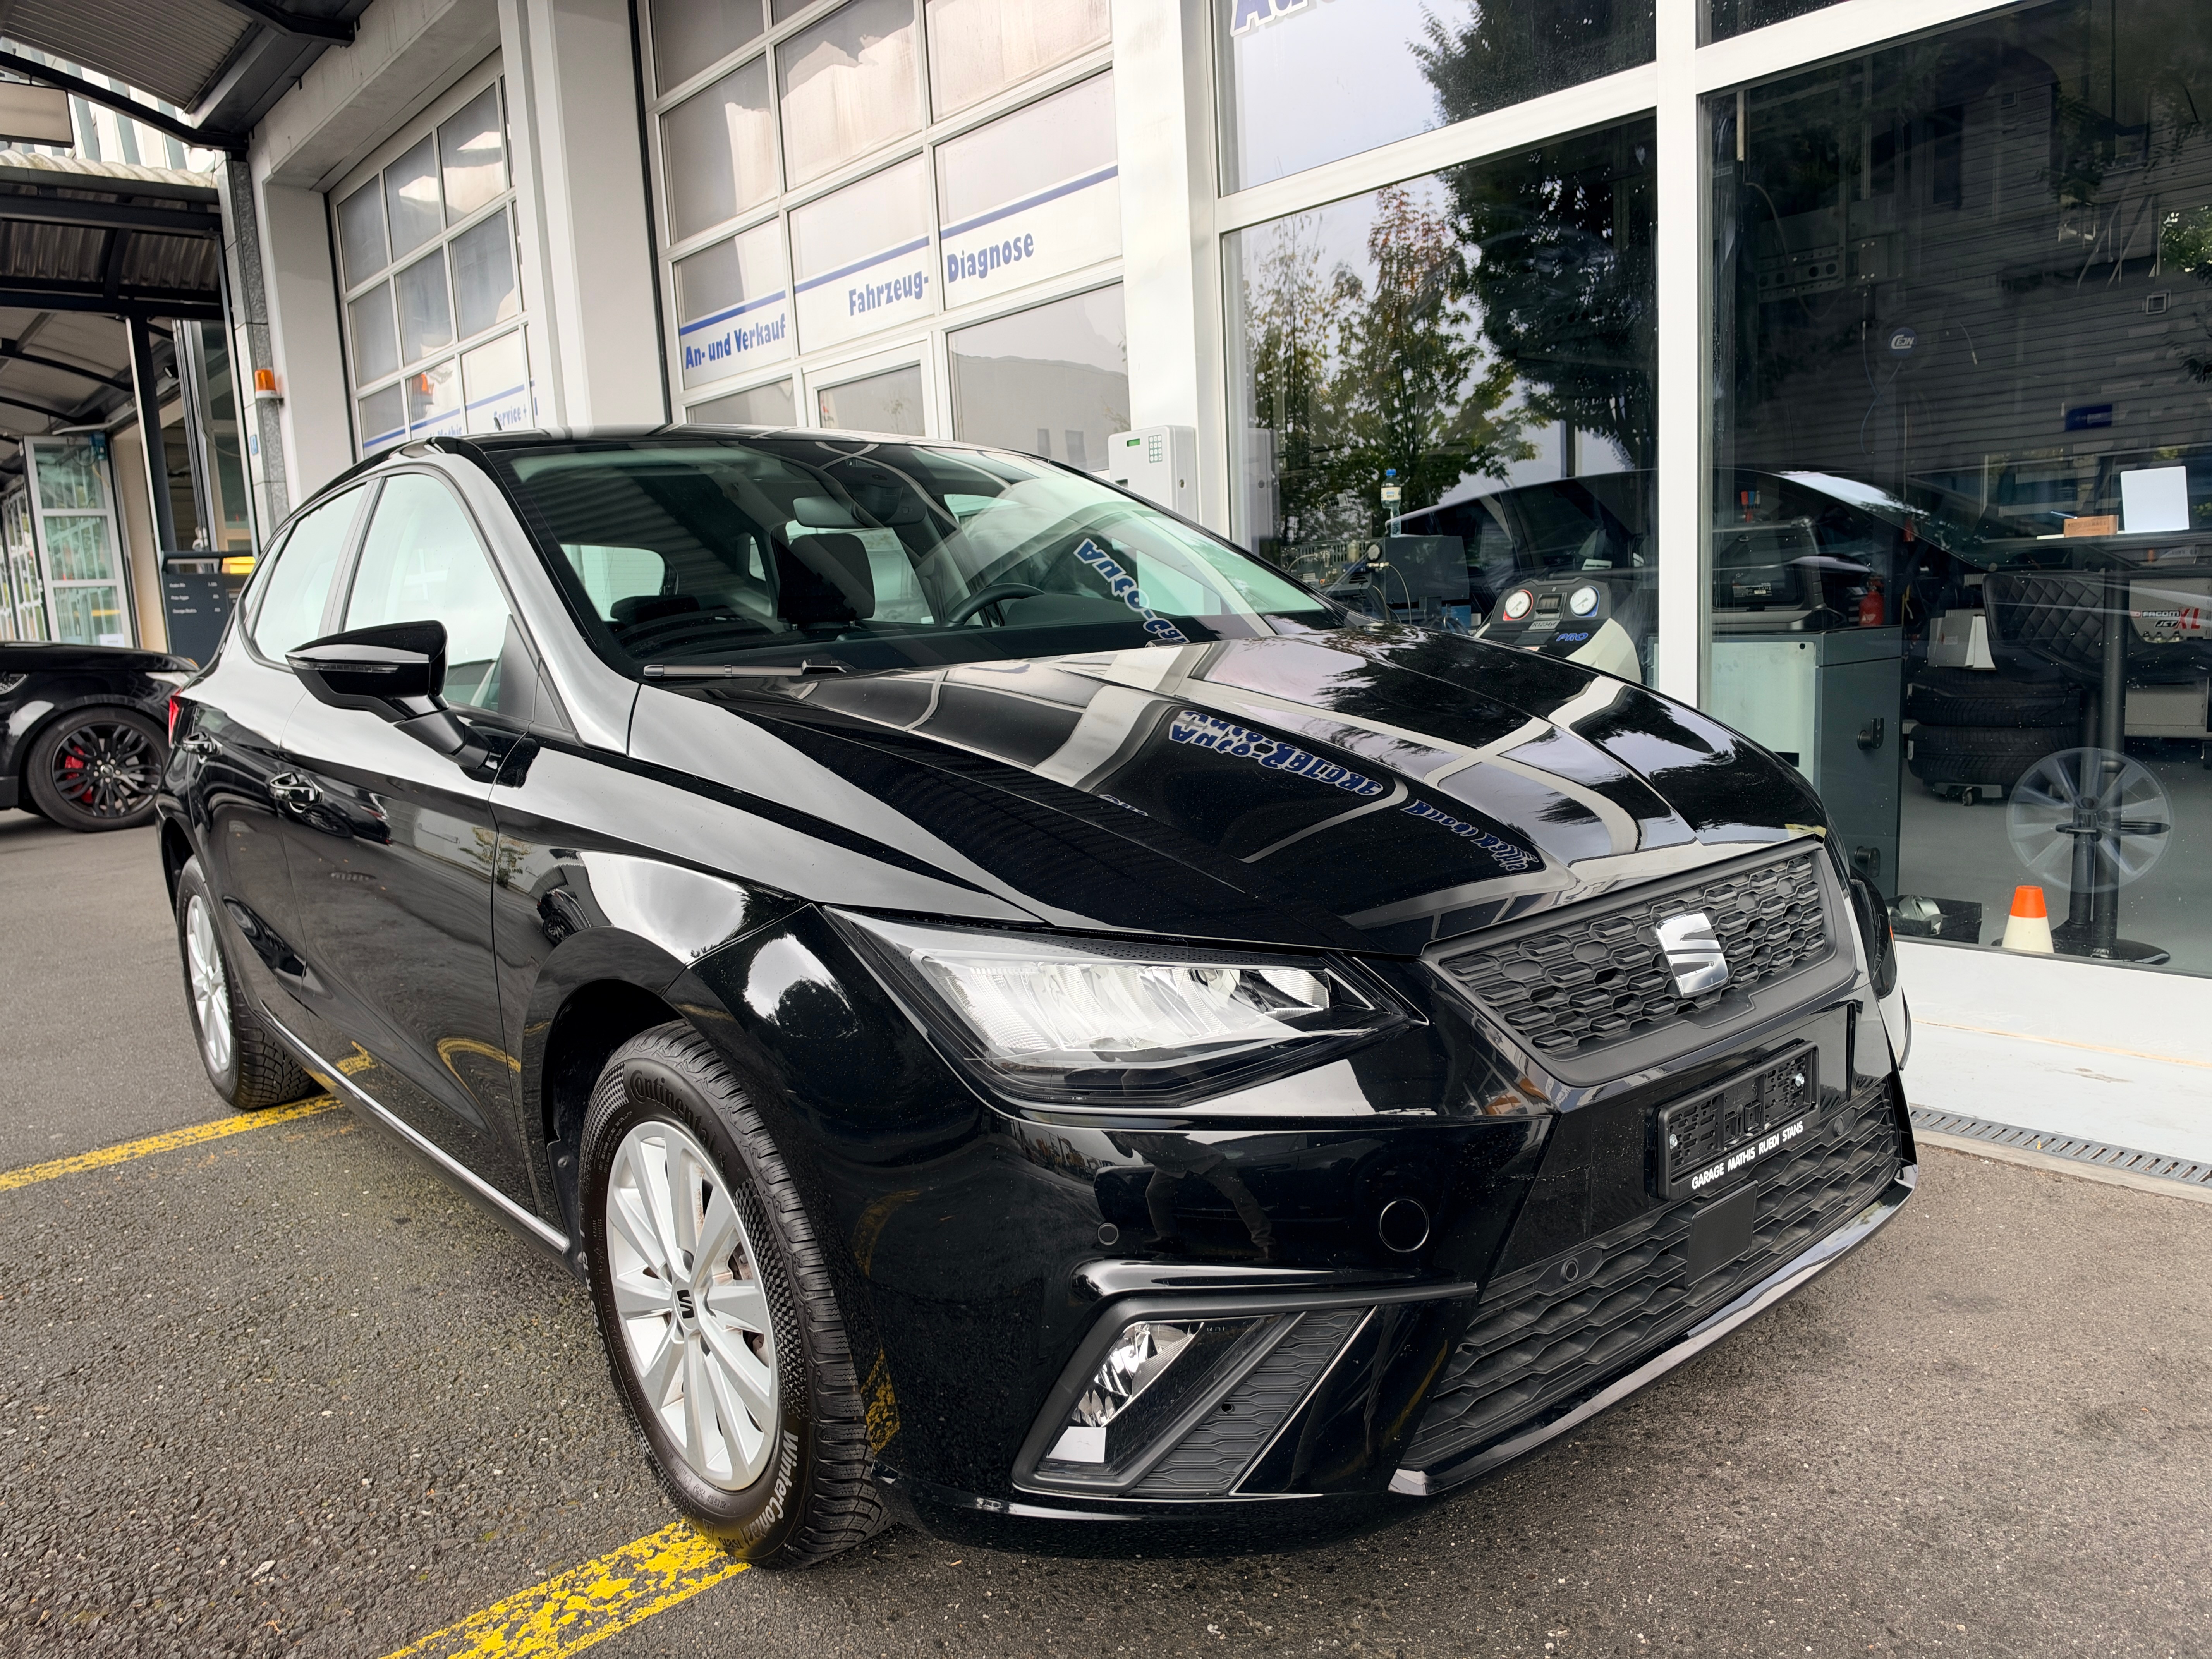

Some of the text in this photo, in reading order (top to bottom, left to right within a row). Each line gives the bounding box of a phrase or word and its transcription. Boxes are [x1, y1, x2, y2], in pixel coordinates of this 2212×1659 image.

[849, 233, 1034, 316] Fahrzeug- Diagnose
[686, 313, 786, 369] An- und Verkauf
[1891, 334, 1914, 349] CEJN
[1556, 632, 1588, 642] PRO
[2174, 608, 2201, 629] XL
[630, 1070, 717, 1152] Continental
[1692, 1120, 1803, 1190] GARAGE MATHIS RUEDI STANS
[739, 1430, 799, 1547] WinterContact
